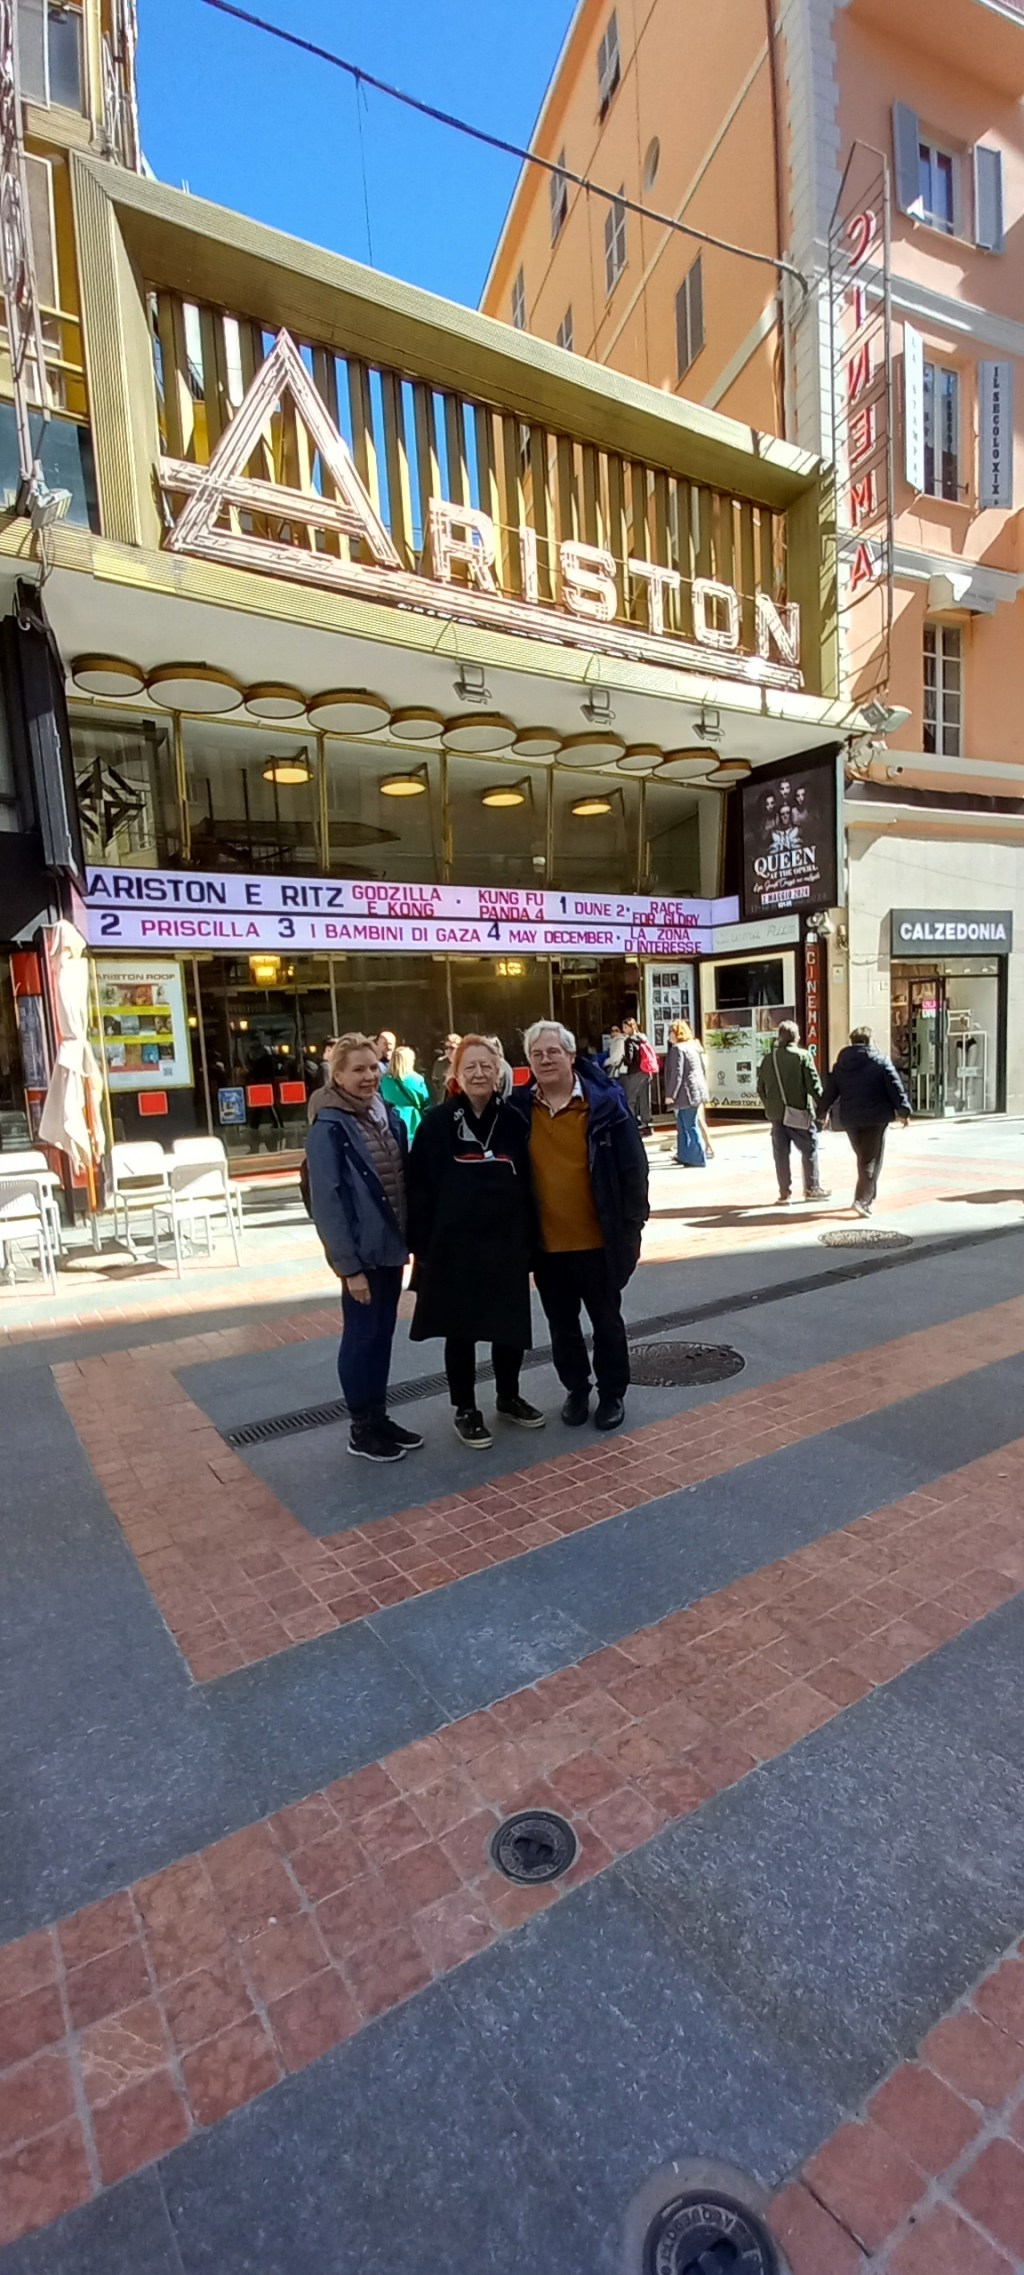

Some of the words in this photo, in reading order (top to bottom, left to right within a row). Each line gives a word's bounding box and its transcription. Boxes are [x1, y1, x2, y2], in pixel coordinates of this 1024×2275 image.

[993, 366, 1000, 389] IL
[992, 391, 1000, 460] SECOLO
[992, 462, 1000, 495] XIX
[160, 328, 801, 667] ARISTON
[754, 845, 817, 879] QUEEN
[88, 873, 227, 904] ARISTON
[245, 883, 262, 905] E
[281, 885, 345, 908] RITZ
[352, 885, 442, 902] GODZILLA
[478, 889, 519, 905] KUNG
[526, 892, 544, 906] FU
[767, 890, 792, 902] MAGGIO
[793, 887, 808, 897] 2024
[367, 901, 378, 916] E
[388, 902, 435, 917] KONG
[479, 905, 530, 921] PANDA
[534, 908, 544, 921] 4
[559, 896, 567, 914] 1
[574, 901, 611, 917] DUNE
[616, 904, 625, 917] 2
[650, 901, 683, 914] RACE
[100, 912, 122, 936] 2
[140, 919, 260, 938] PRISCILLA
[278, 917, 296, 938] 3
[311, 923, 316, 938] I
[325, 923, 403, 941] BAMBINI
[411, 927, 428, 942] DI
[436, 928, 481, 942] GAZA
[487, 921, 501, 941] 4
[509, 929, 537, 944] MAY
[544, 930, 613, 944] DECEMBER
[632, 912, 656, 925] FOR
[664, 912, 700, 926] GLORY
[630, 927, 646, 940] LA
[657, 928, 690, 941] ZONA
[900, 922, 1007, 940] CALZEDONIA
[806, 951, 817, 1039] CINEMA
